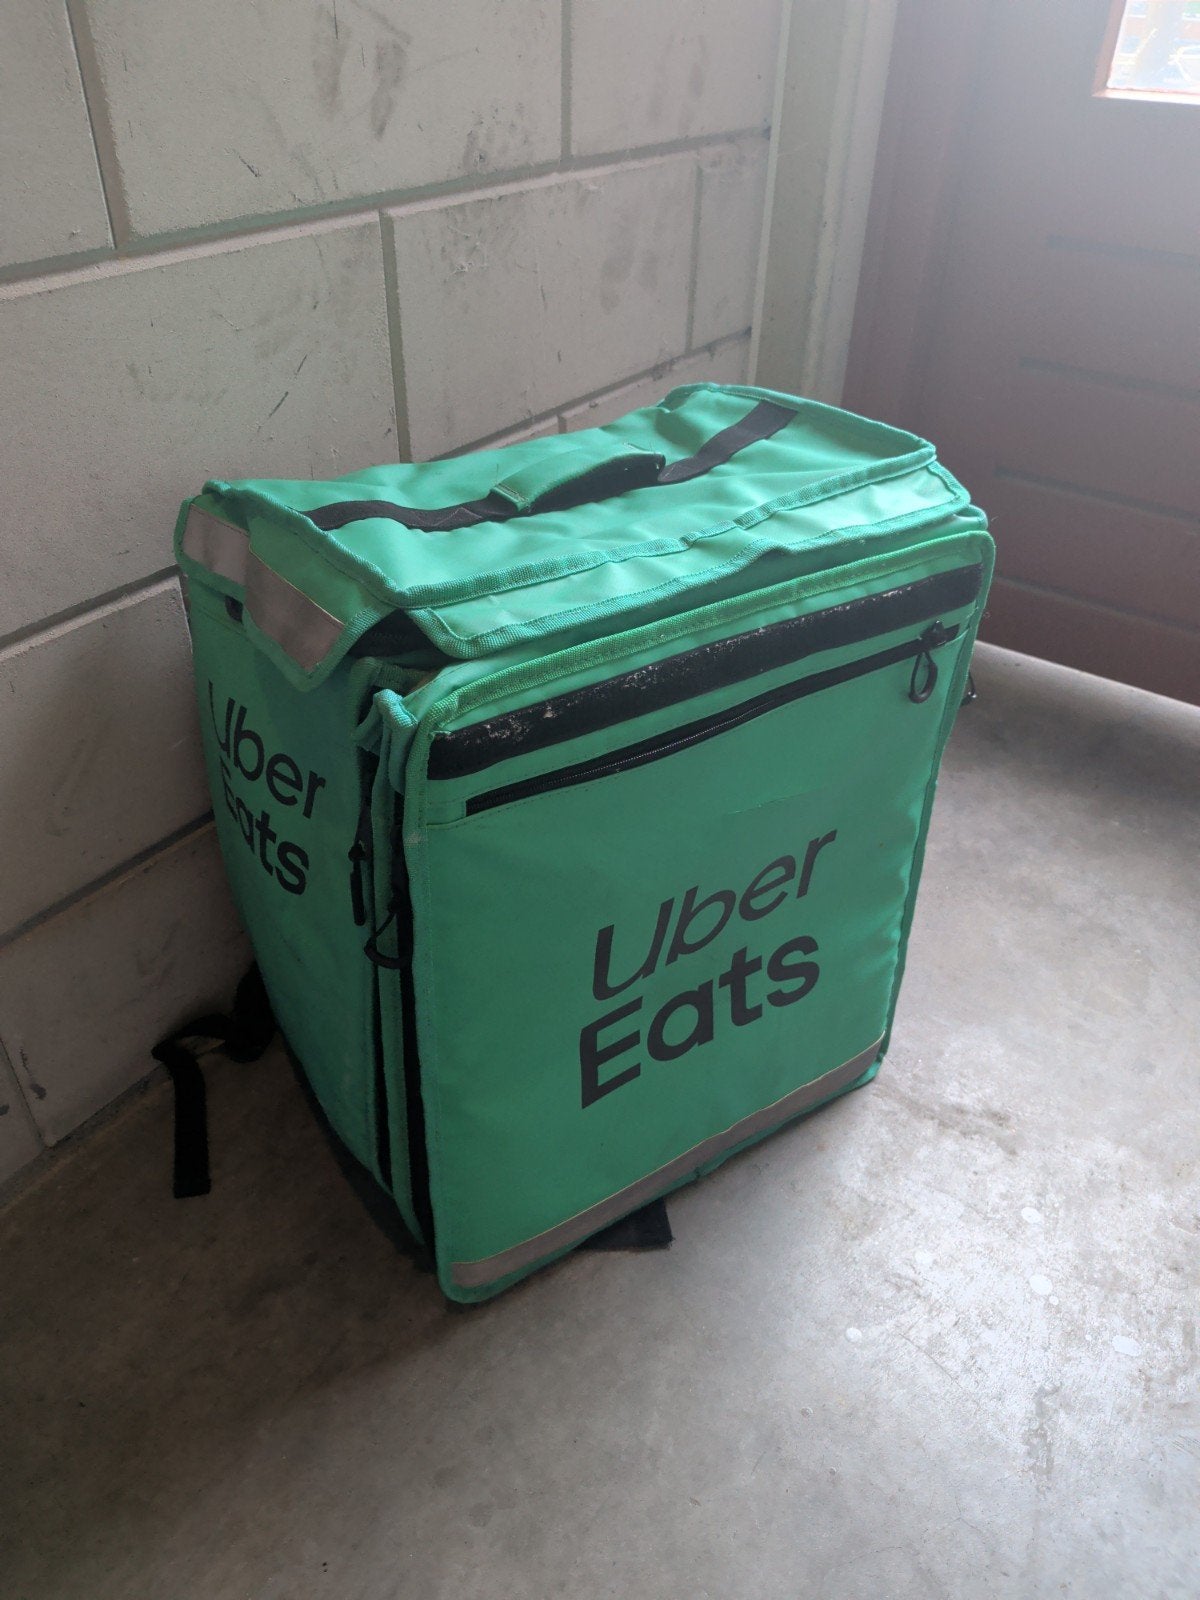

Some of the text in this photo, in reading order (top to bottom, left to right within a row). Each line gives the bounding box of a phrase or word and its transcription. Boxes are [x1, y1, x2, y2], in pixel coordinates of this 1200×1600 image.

[208, 679, 326, 819] Uber
[220, 755, 309, 895] Eats
[593, 829, 837, 1001] Uber
[580, 935, 820, 1109] Eats
